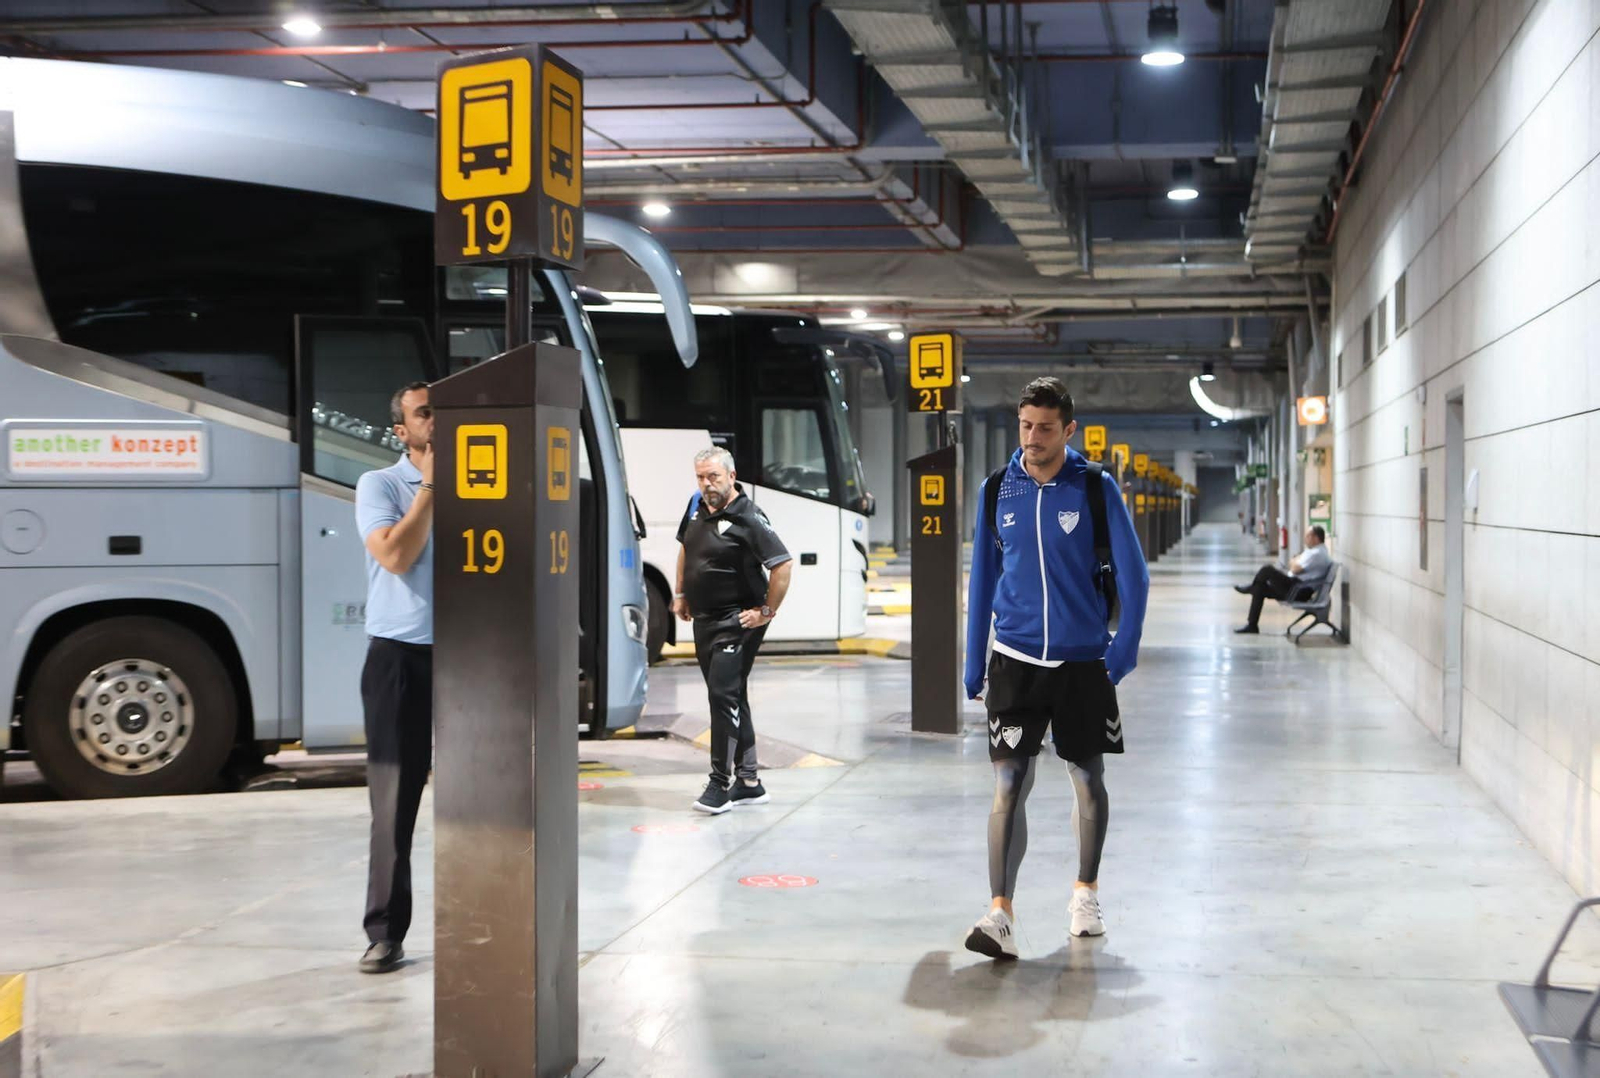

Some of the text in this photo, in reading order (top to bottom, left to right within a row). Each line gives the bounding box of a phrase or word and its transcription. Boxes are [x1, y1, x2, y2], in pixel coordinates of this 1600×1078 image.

[461, 200, 512, 255] 19
[551, 204, 574, 260] 19
[919, 389, 944, 411] 21
[14, 434, 198, 455] another konzept
[921, 515, 942, 535] 21
[461, 528, 505, 574] 19
[549, 530, 569, 574] 19
